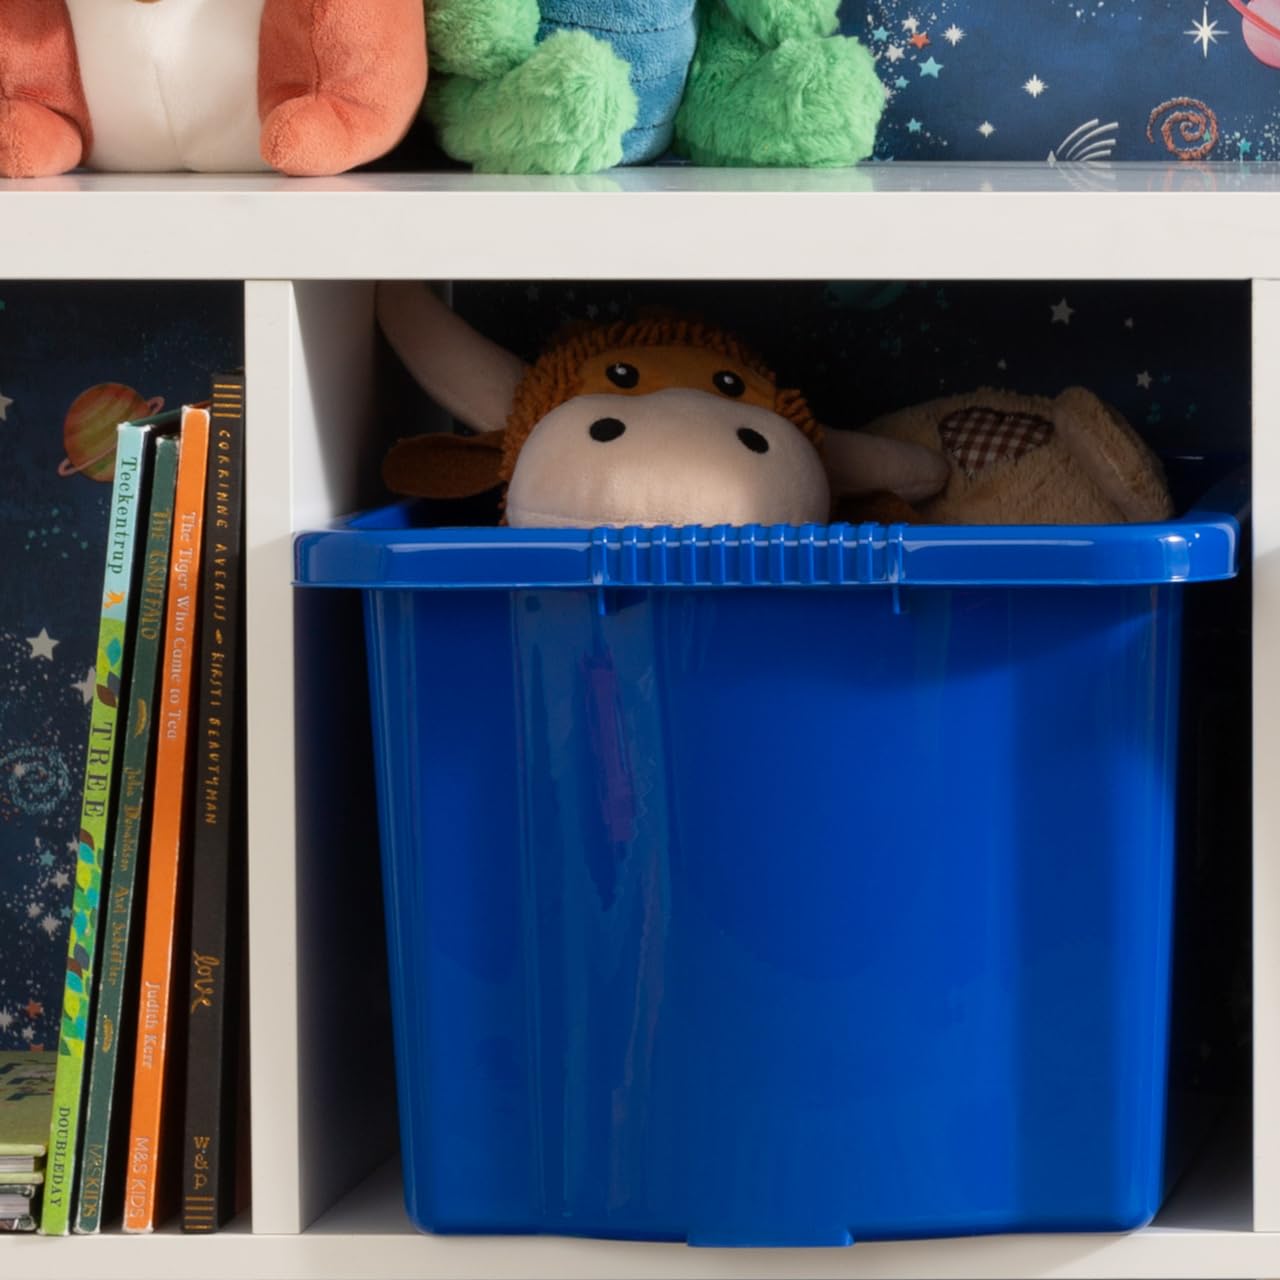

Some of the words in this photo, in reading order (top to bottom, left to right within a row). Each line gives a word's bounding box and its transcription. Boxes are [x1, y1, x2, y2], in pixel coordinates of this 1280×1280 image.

[216, 429, 231, 529] CORRINNE
[107, 456, 138, 574] Teckentrup
[151, 508, 171, 540] THE
[180, 511, 197, 542] The
[175, 547, 194, 590] Tiger
[140, 550, 169, 640] GRUFFALO
[175, 594, 191, 632] Who
[170, 637, 186, 682] Came
[211, 651, 224, 706] KIRSTI
[169, 688, 182, 704] to
[167, 709, 182, 740] Tea
[84, 721, 113, 818] TREE
[205, 716, 222, 825] BEAUTYMAN
[191, 949, 221, 1014] love
[145, 981, 161, 1029] Judith
[142, 1034, 157, 1069] Kerr
[51, 1107, 70, 1208] DOUBLEDAY
[133, 1137, 150, 1174] M&S
[129, 1181, 147, 1218] KIDS
